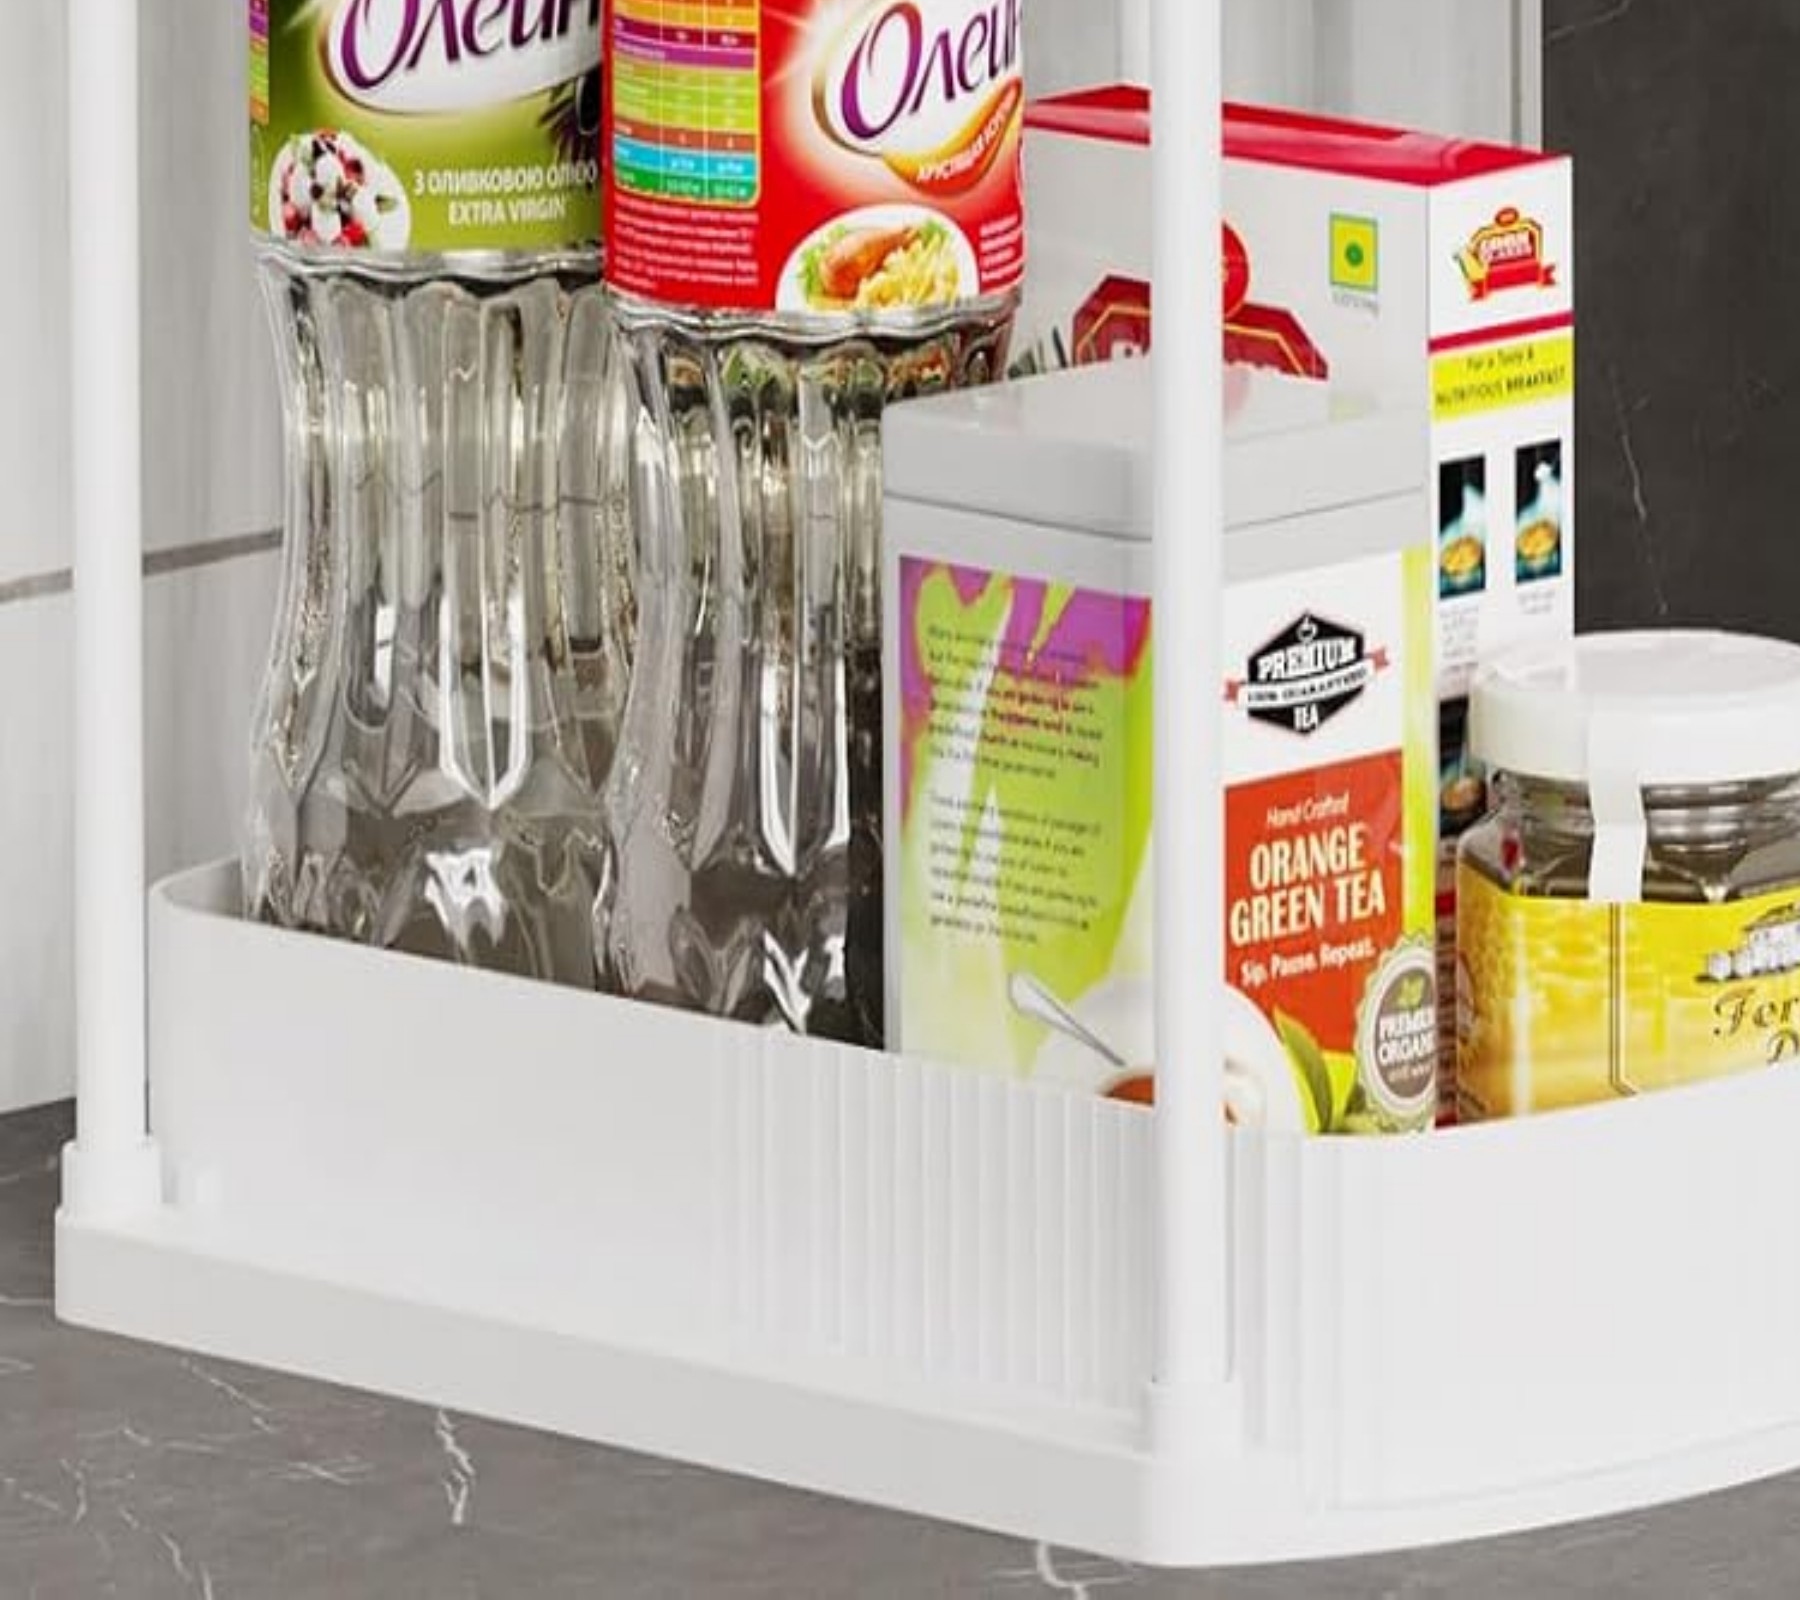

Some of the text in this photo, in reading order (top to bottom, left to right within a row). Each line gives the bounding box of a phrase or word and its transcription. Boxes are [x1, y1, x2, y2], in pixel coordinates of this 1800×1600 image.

[449, 196, 567, 226] EXTRA VIRGIN
[1256, 637, 1358, 681] PREMIUM
[1292, 703, 1320, 731] TEA
[1248, 821, 1369, 890] ORANGE
[1230, 868, 1387, 947] GREEN TEA
